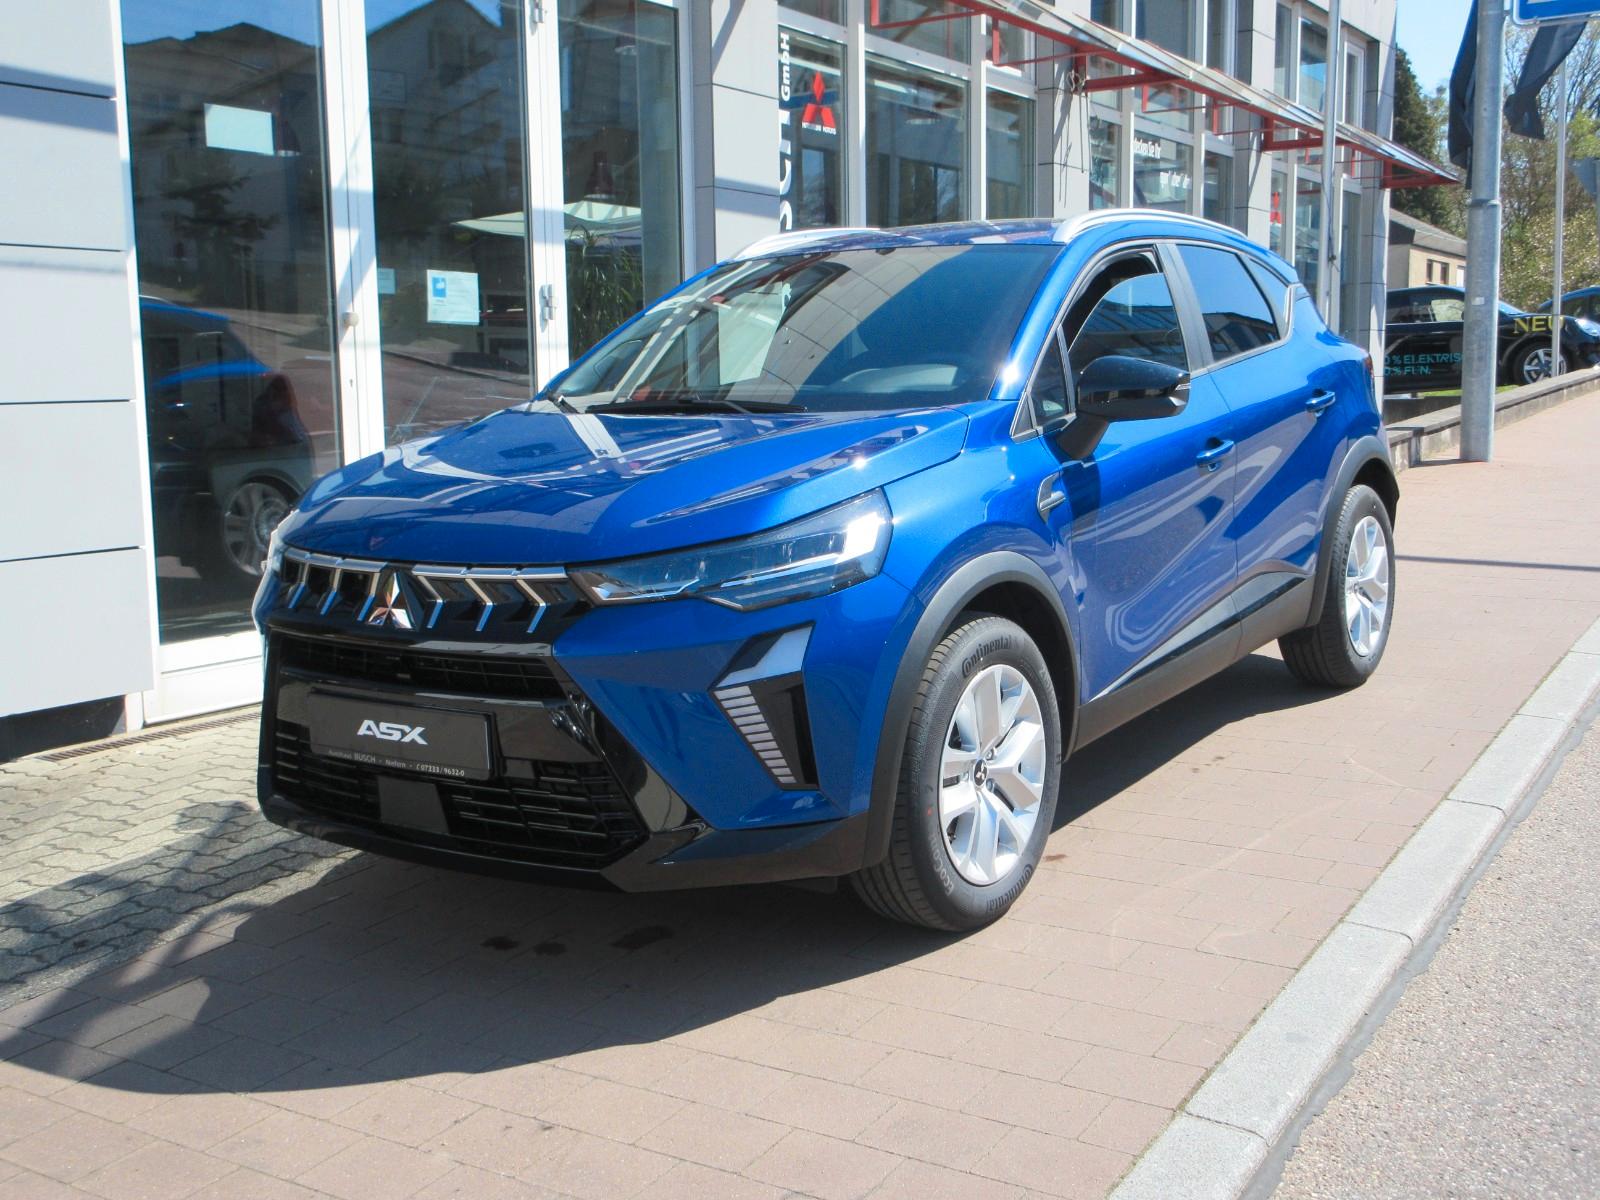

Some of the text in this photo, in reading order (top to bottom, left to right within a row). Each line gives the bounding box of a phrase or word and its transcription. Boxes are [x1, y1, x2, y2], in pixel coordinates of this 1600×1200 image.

[780, 32, 791, 101] GmbH
[1512, 315, 1565, 334] NEU
[961, 634, 1012, 678] Continental
[357, 719, 428, 745] ASX
[354, 751, 376, 764] BUSCH
[986, 863, 1034, 914] Continental
